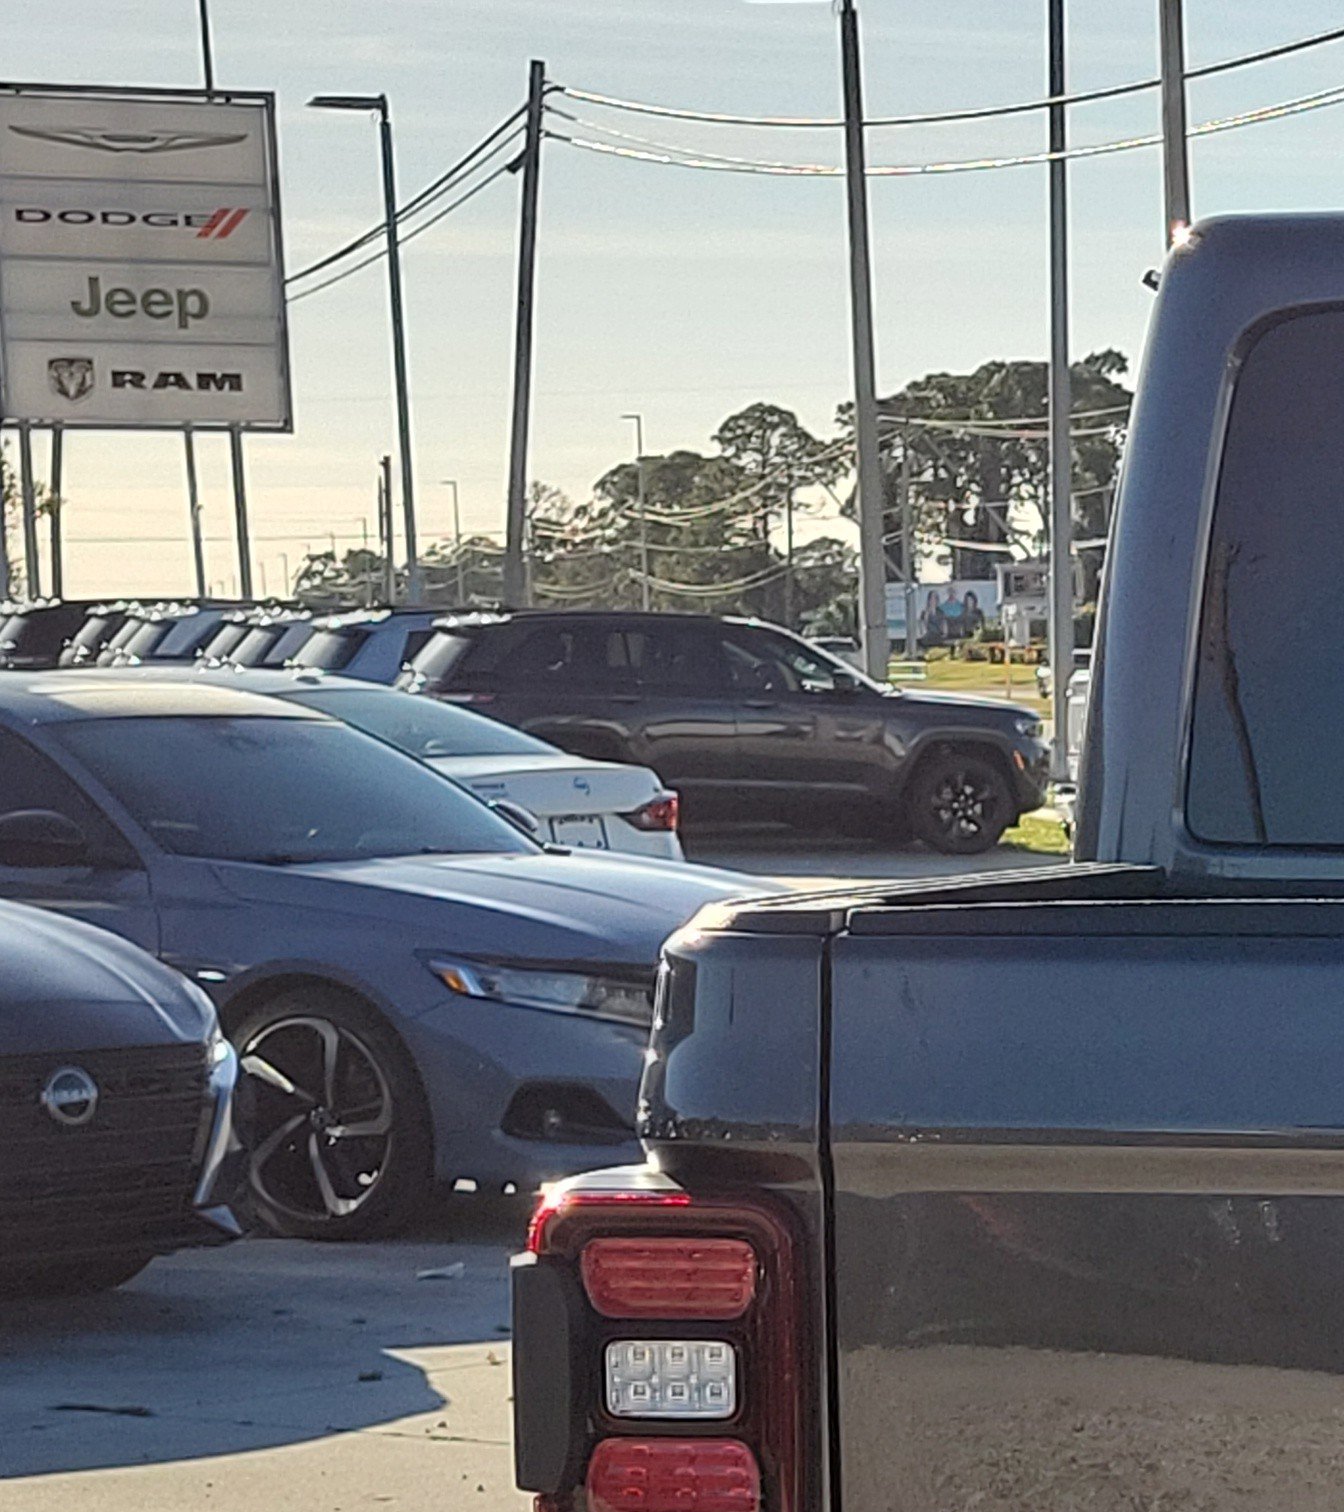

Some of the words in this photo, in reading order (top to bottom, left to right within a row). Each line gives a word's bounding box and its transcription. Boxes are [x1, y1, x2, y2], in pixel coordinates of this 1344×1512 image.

[15, 208, 215, 230] DODGE
[71, 276, 210, 329] Jeep
[111, 370, 243, 391] RAM
